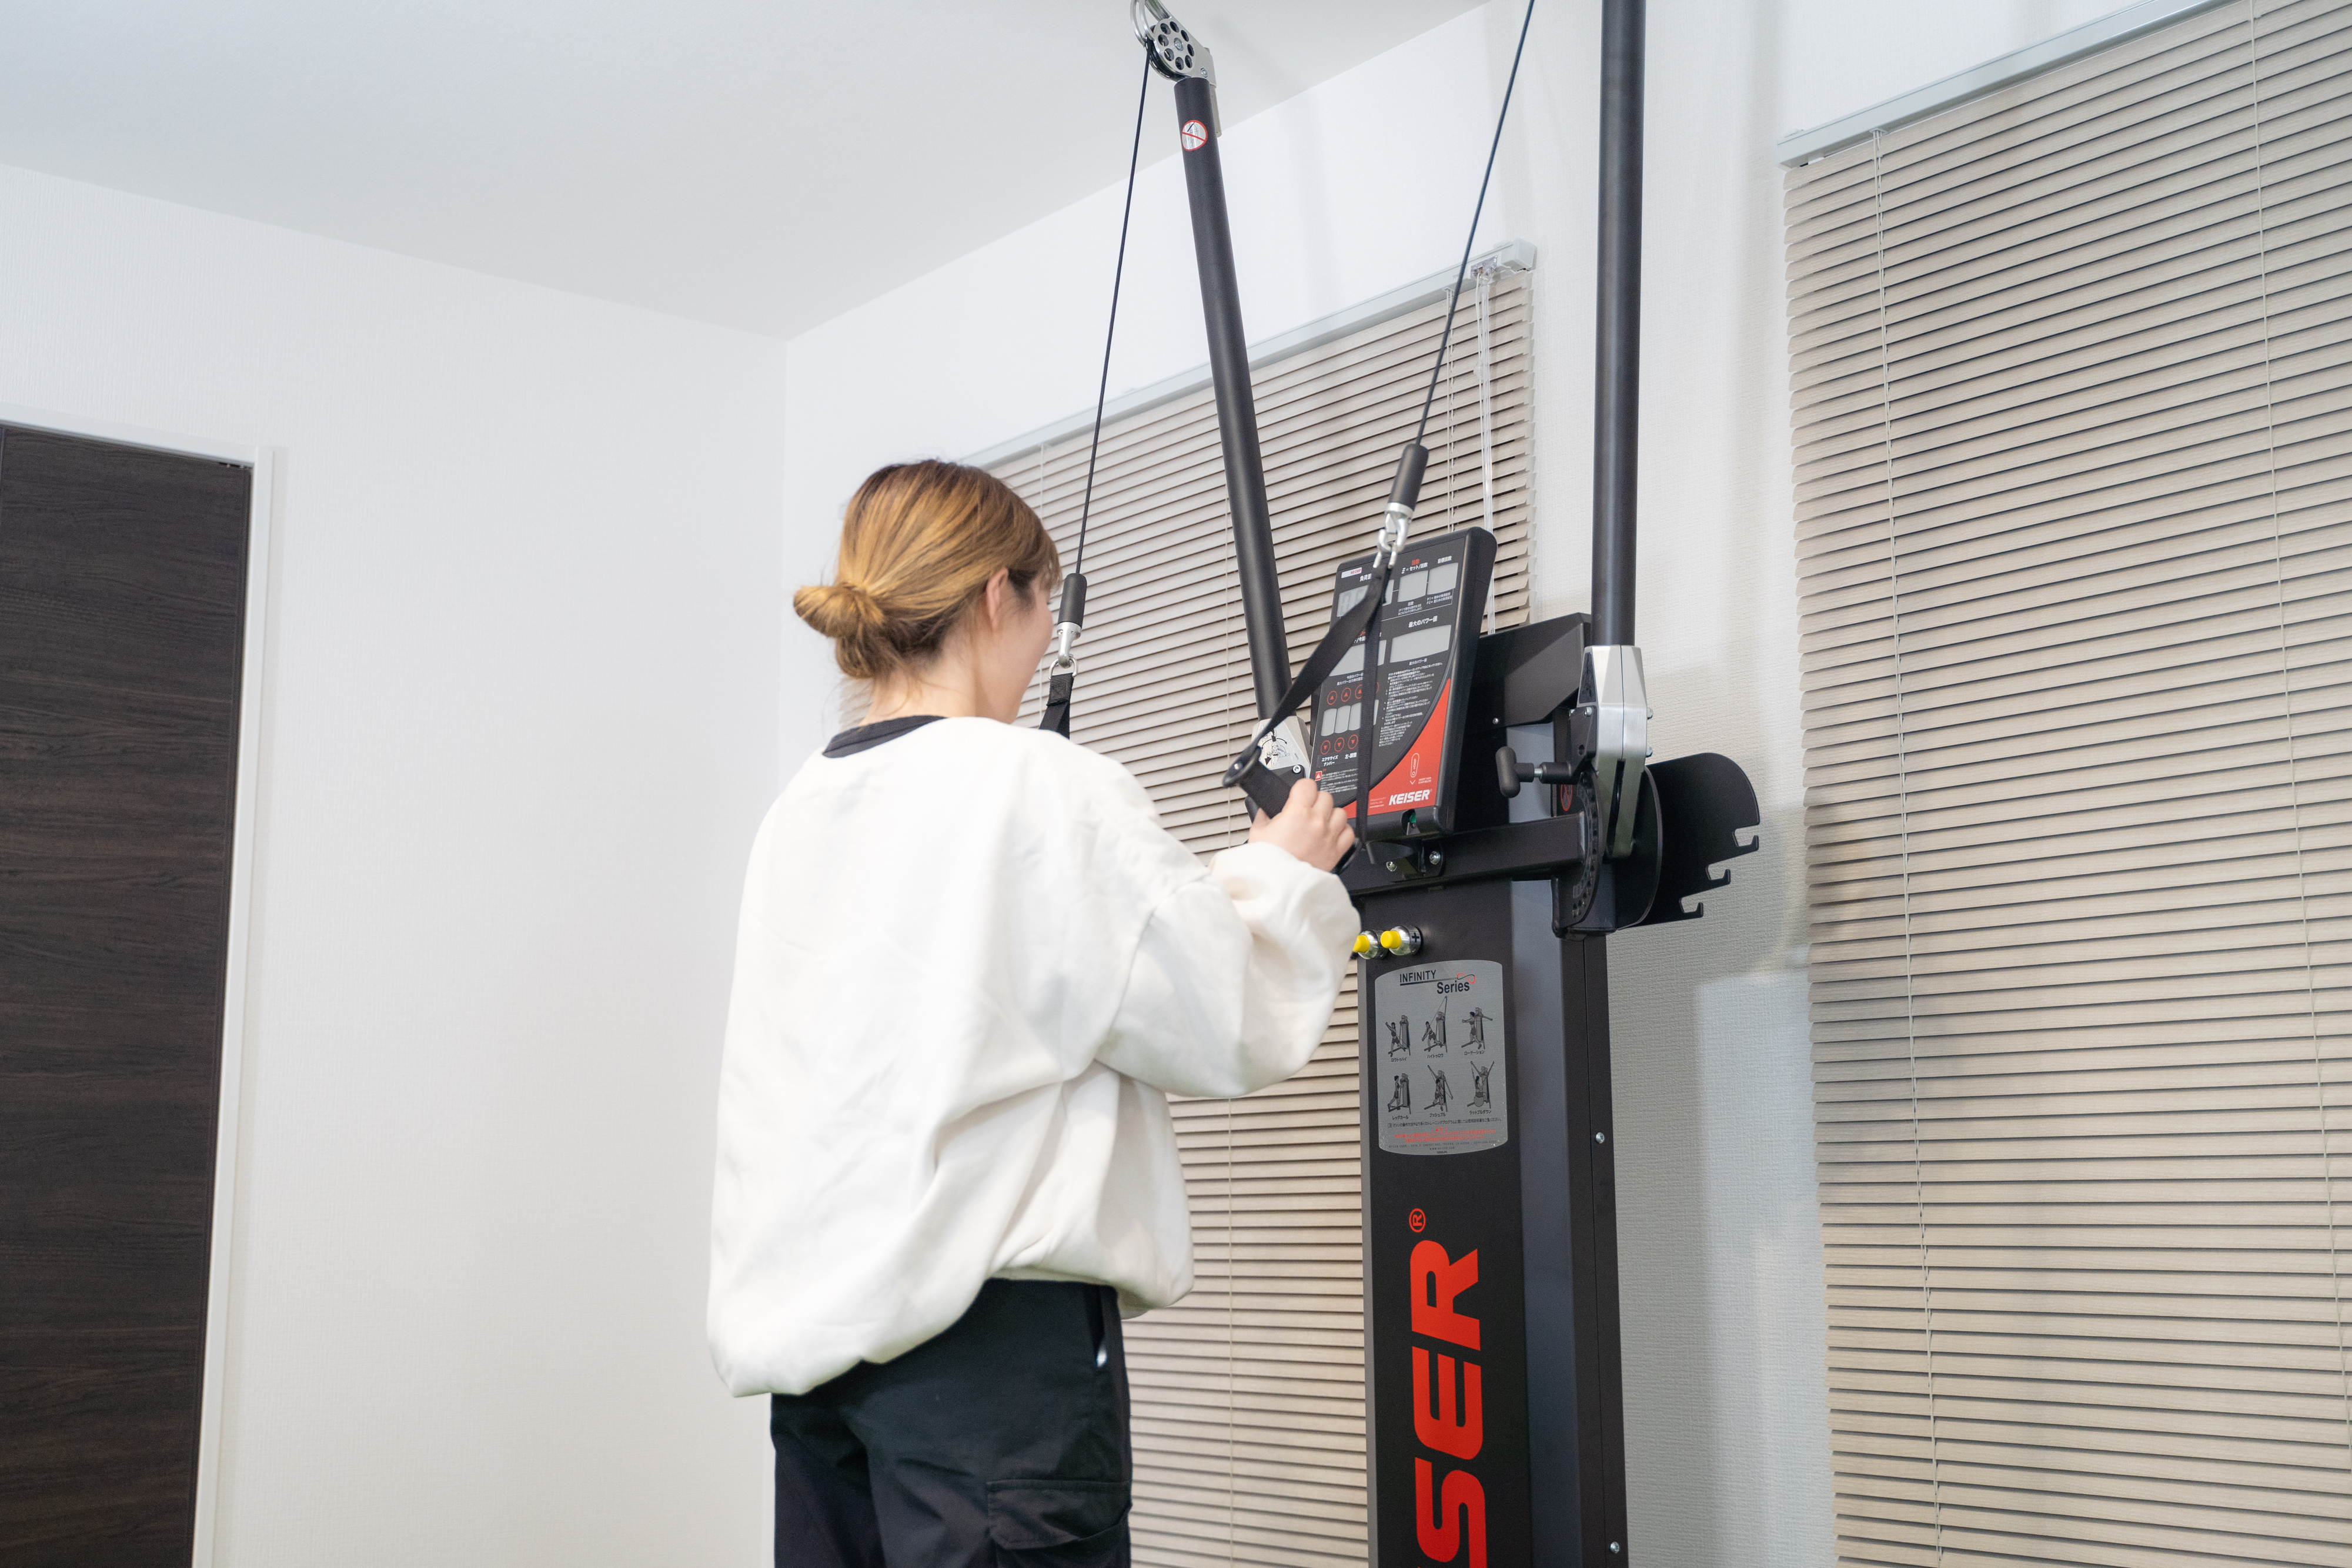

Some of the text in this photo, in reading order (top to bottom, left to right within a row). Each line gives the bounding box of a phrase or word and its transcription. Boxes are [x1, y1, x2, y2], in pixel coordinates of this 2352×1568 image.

[1408, 616, 1438, 628] 最大のパワー値
[1399, 969, 1436, 983] INFINITY
[1436, 980, 1470, 994] Series
